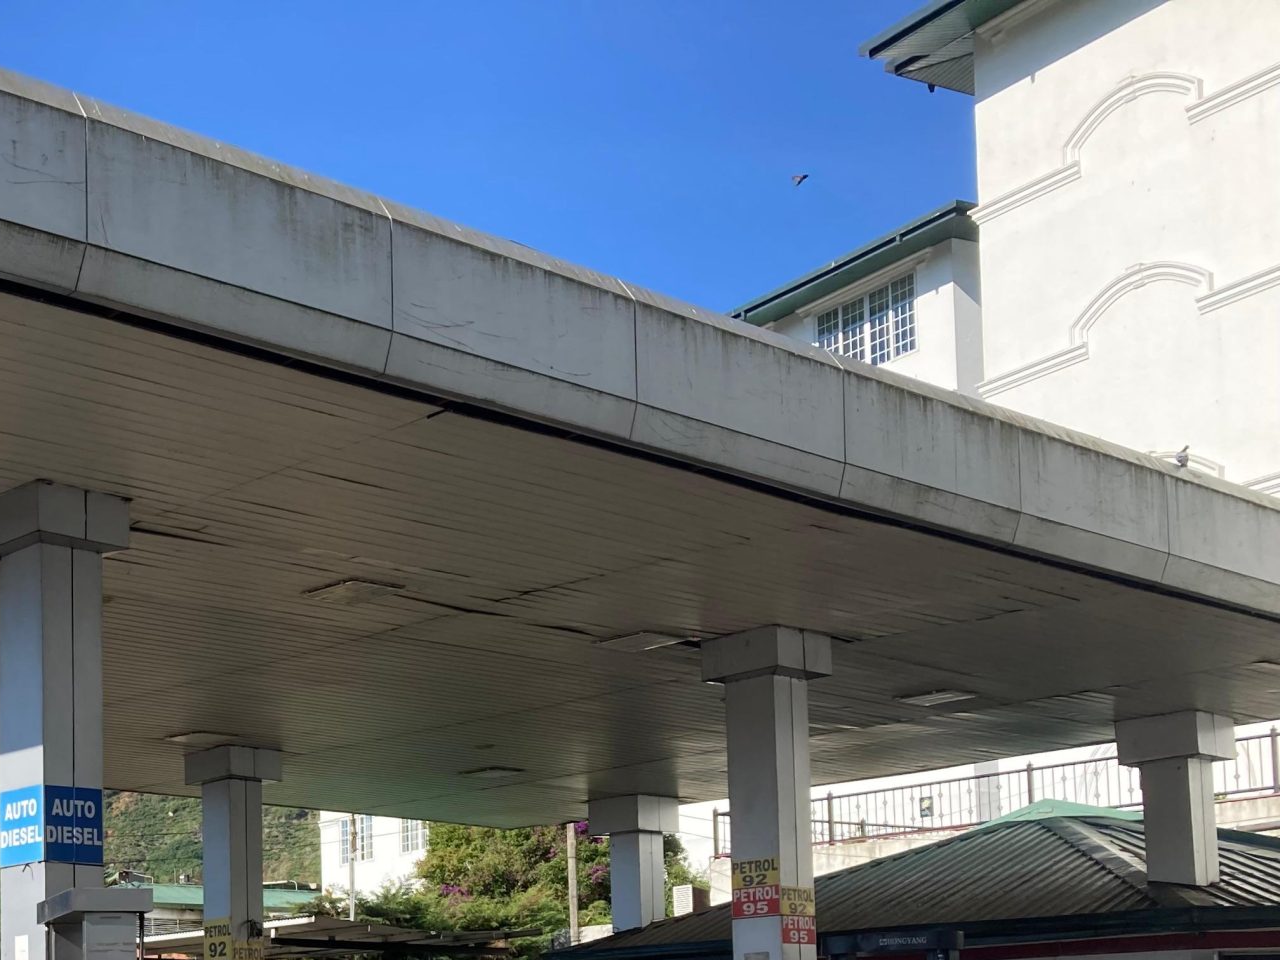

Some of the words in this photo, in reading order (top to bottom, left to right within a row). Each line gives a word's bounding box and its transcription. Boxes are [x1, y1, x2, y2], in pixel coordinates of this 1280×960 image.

[5, 798, 37, 821] AUTO
[51, 798, 96, 819] AUTO
[0, 825, 43, 849] DIESEL
[46, 825, 103, 846] DIESEL
[732, 858, 778, 875] PETROL
[742, 874, 768, 887] 92
[733, 886, 779, 900] PETROL
[782, 888, 813, 902] PETROL
[742, 901, 769, 915] 95
[788, 902, 807, 915] 92
[782, 915, 815, 929] PETROL
[204, 923, 231, 938] PETROL
[789, 930, 809, 943] 95
[208, 941, 227, 957] 92
[232, 946, 265, 960] PETROL
